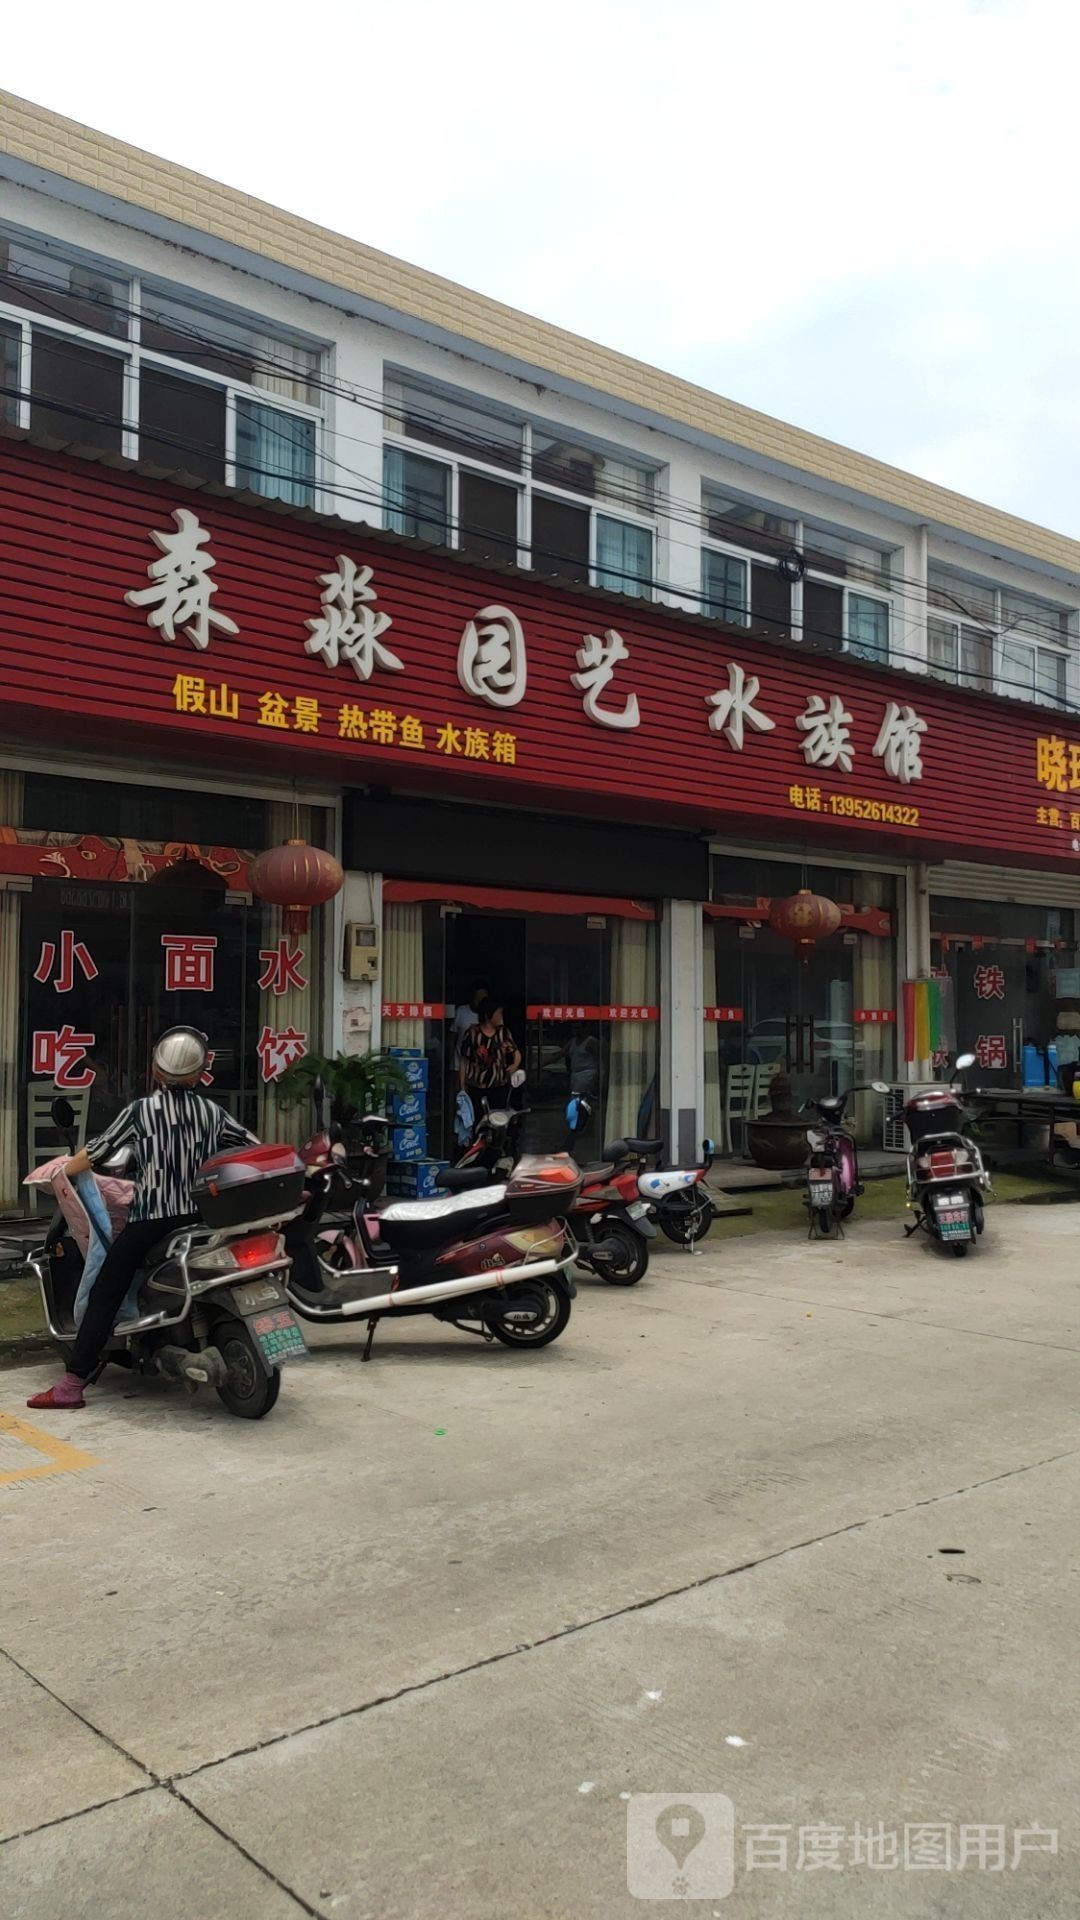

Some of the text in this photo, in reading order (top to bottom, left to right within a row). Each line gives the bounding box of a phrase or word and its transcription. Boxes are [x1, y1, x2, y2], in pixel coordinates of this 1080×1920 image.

[173, 673, 518, 765] 假山 盆景 热带鱼 水族箱
[33, 930, 99, 1089] 小吃
[257, 939, 309, 1083] 水饺
[974, 965, 1007, 1068] 铁锅
